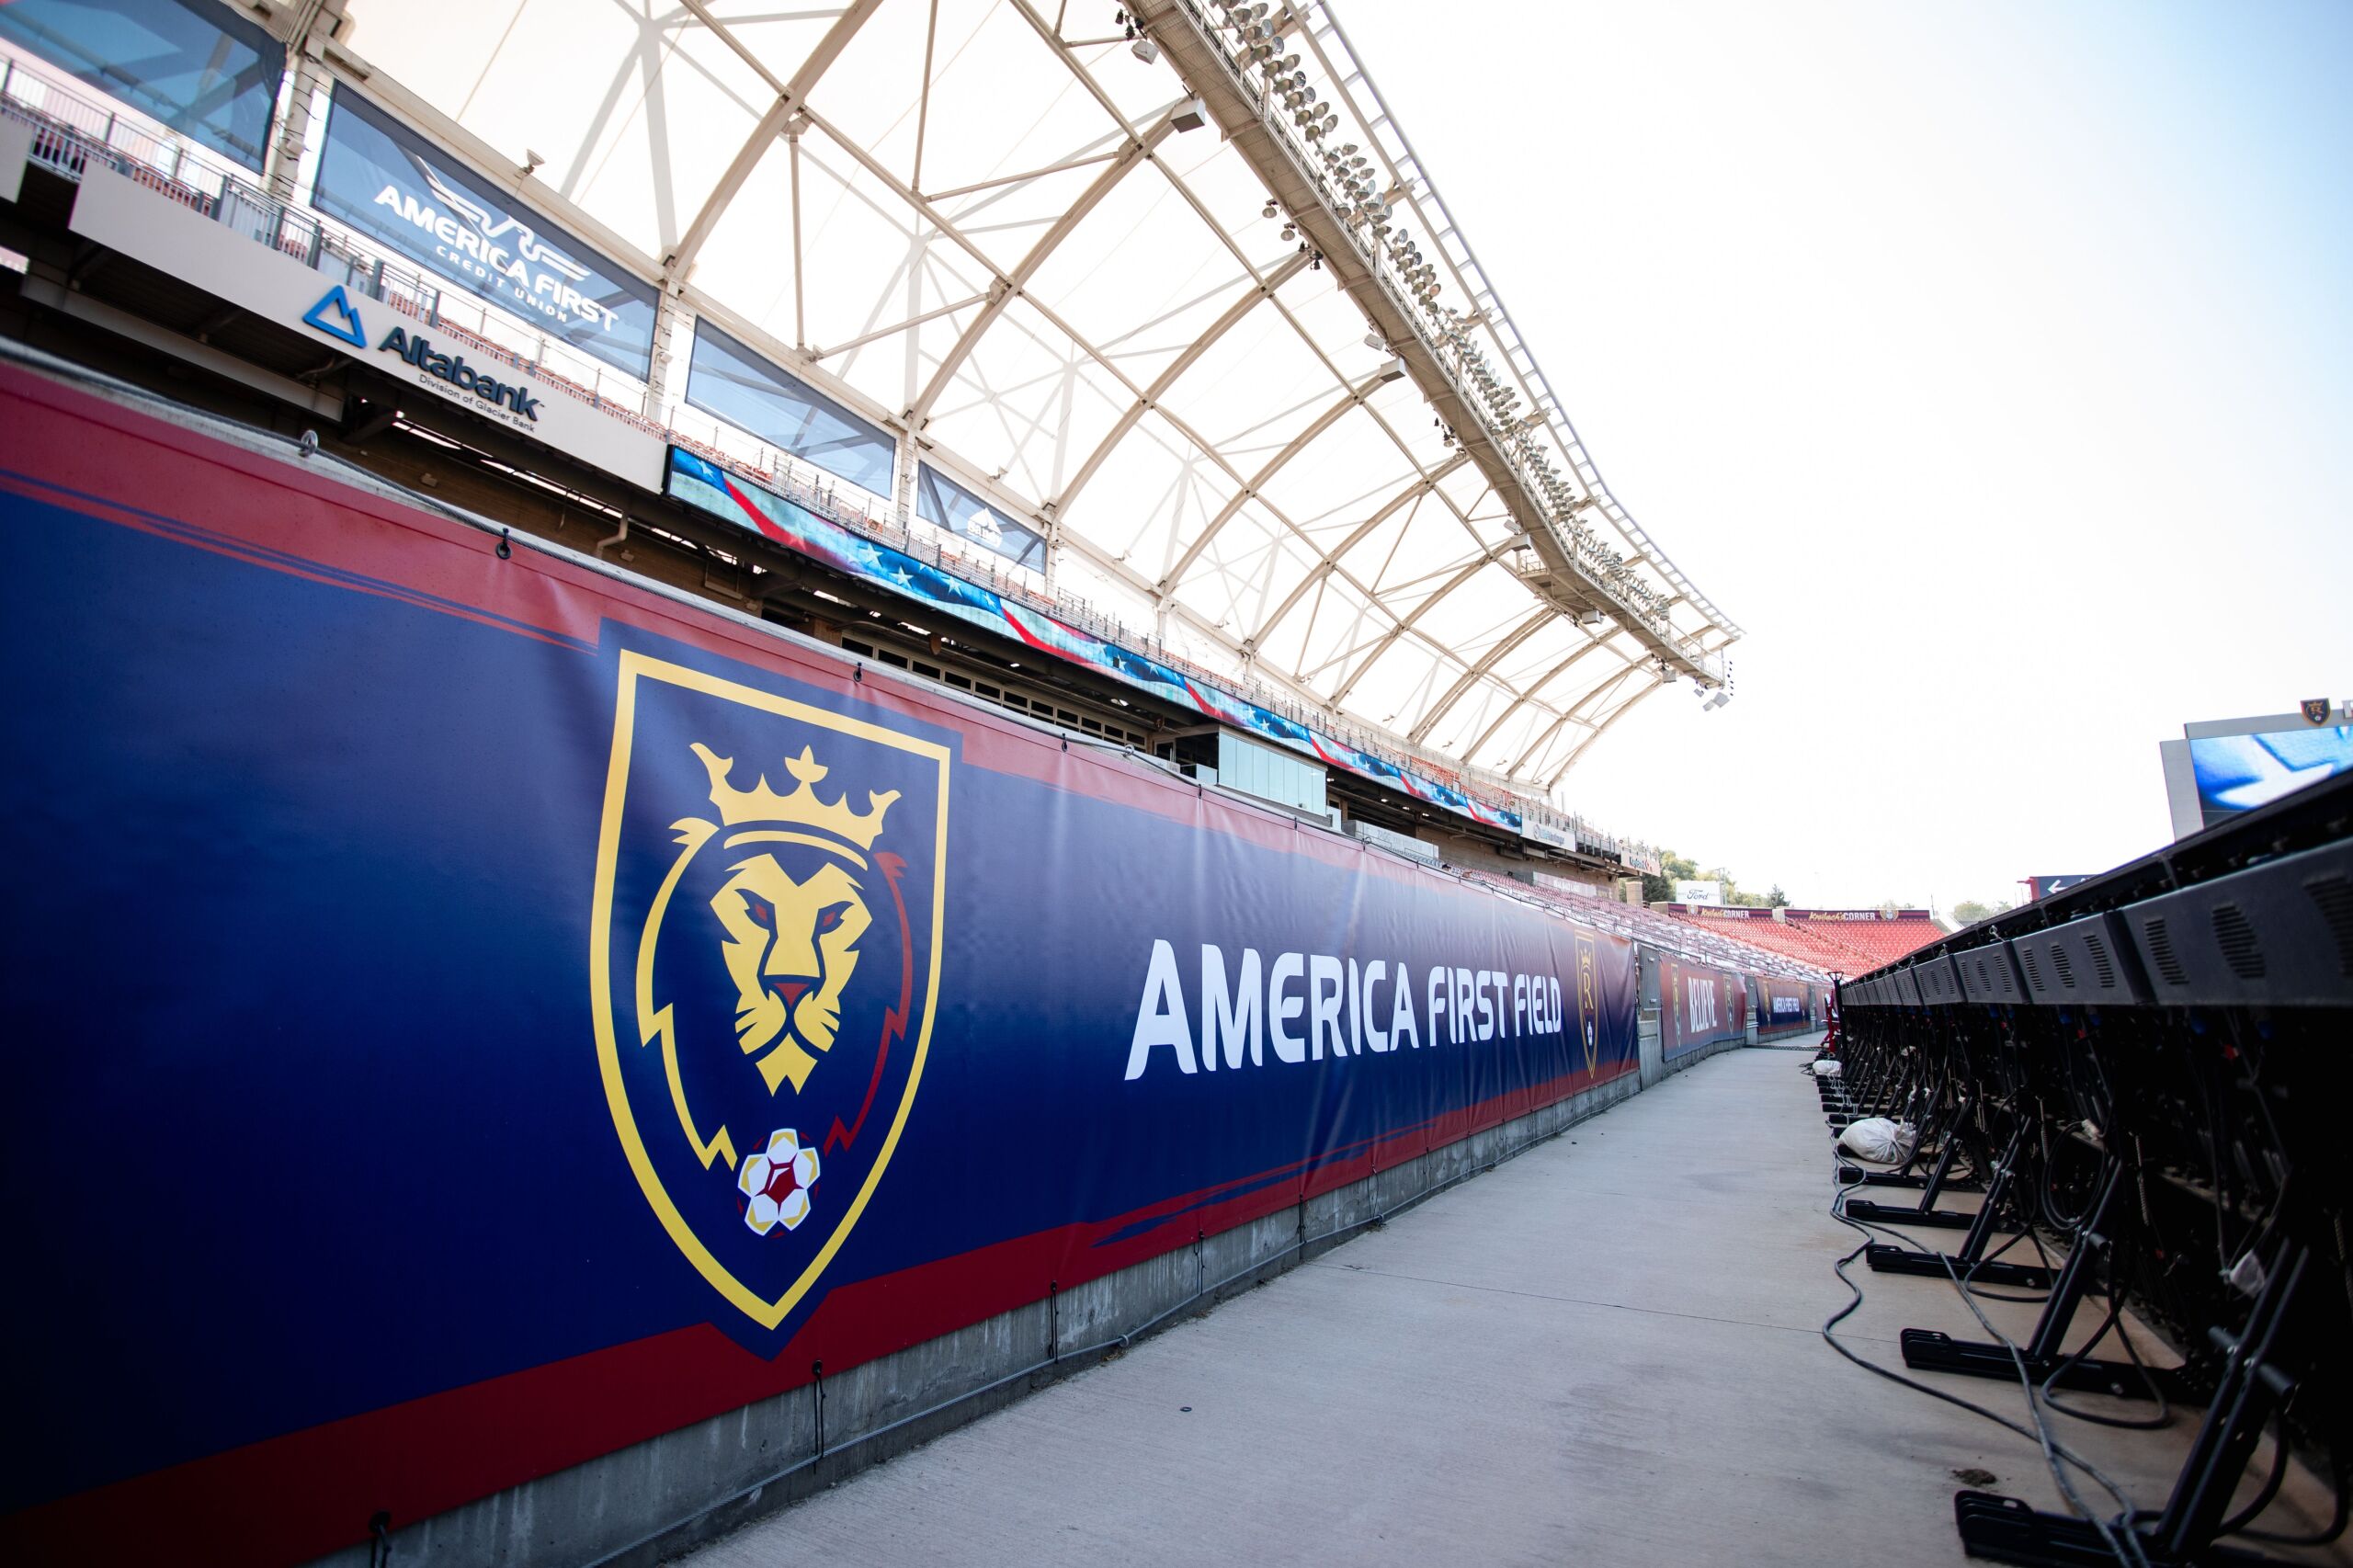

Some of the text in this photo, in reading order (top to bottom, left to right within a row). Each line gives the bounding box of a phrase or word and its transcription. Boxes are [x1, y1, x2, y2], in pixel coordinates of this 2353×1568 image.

[374, 185, 620, 332] AMERICA FIRST
[436, 245, 567, 323] CREDIT UNION
[377, 325, 540, 422] Altabank
[419, 374, 535, 433] Division of Glacier Bank
[1687, 889, 1710, 900] Ford
[1723, 909, 1750, 919] CORNER
[1844, 912, 1876, 921] CORNER
[1123, 938, 1562, 1081] AMERICA FIRST FIELD
[1688, 976, 1717, 1034] BELIEVE
